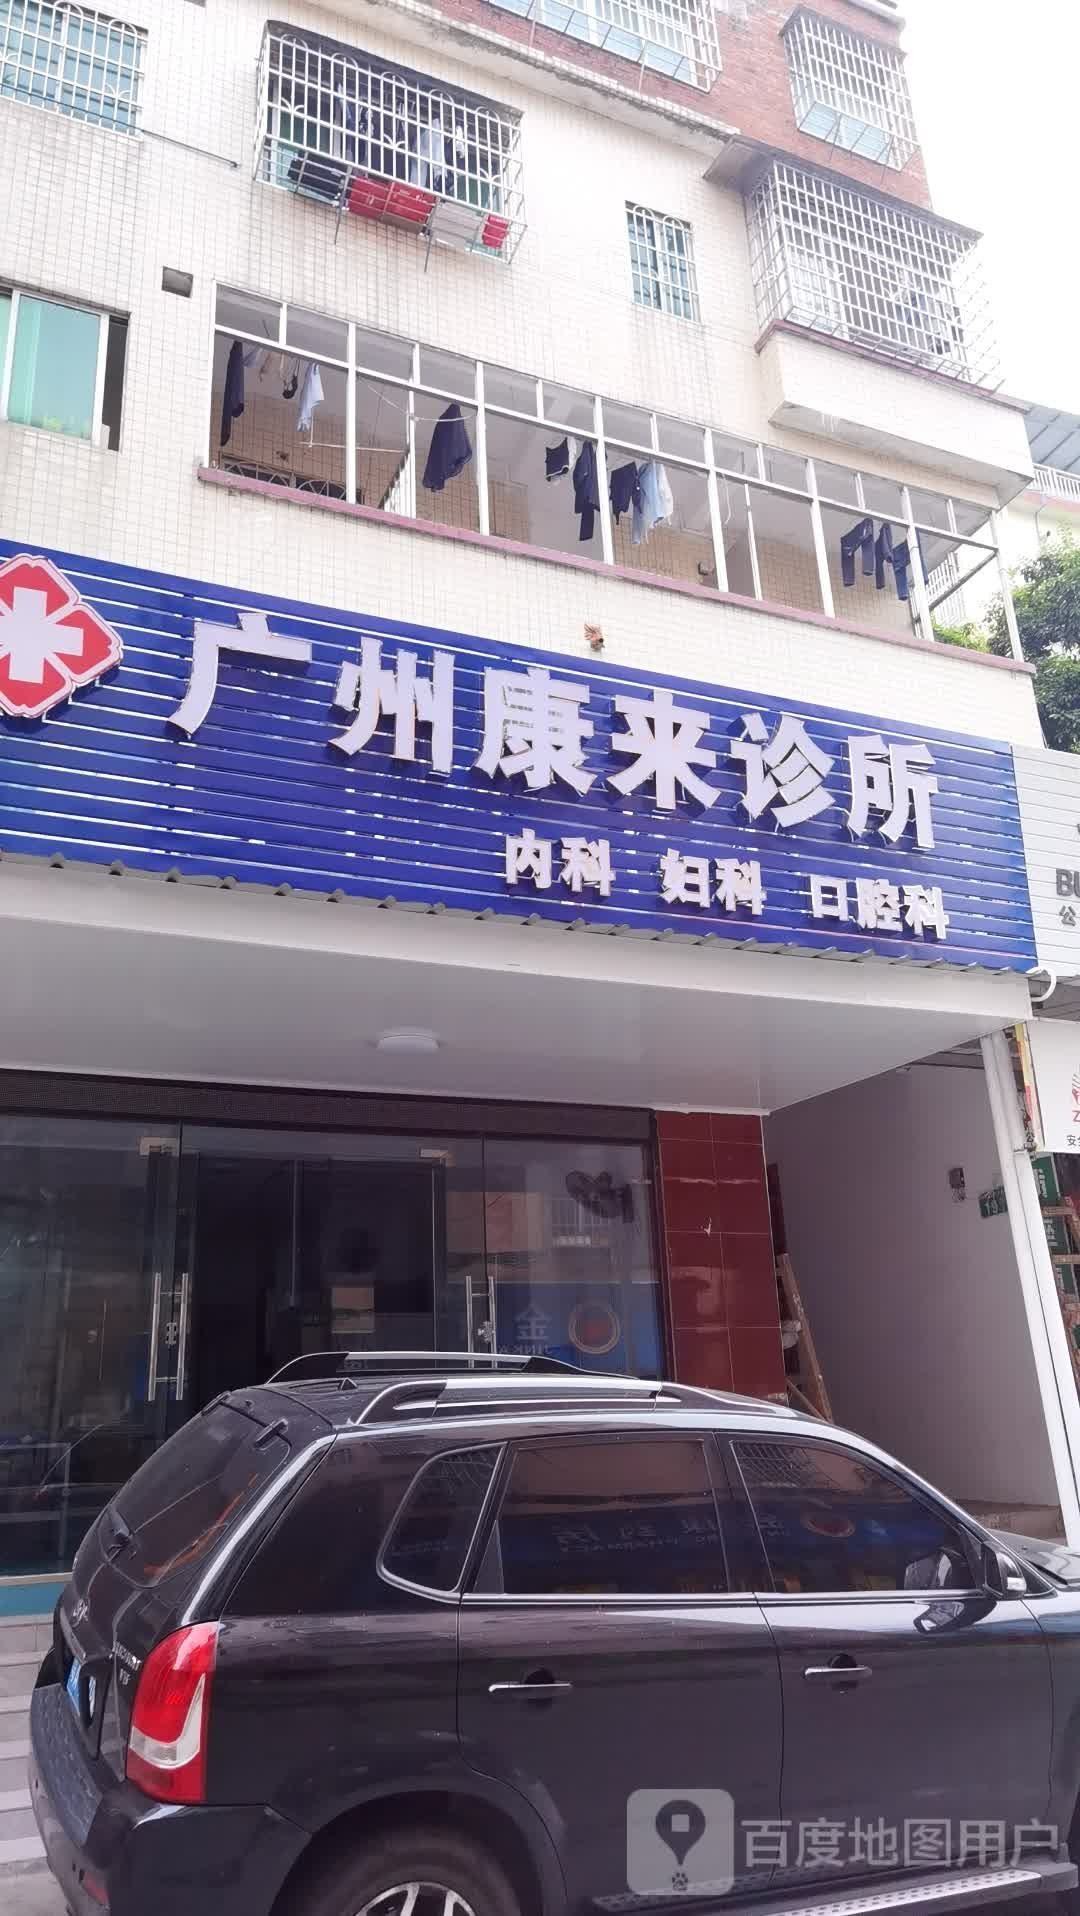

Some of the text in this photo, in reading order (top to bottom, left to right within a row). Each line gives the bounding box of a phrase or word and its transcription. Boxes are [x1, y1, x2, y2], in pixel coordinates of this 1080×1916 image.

[166, 612, 939, 849] 广州康来诊所
[506, 828, 949, 939] 内科 妇科 口腔科
